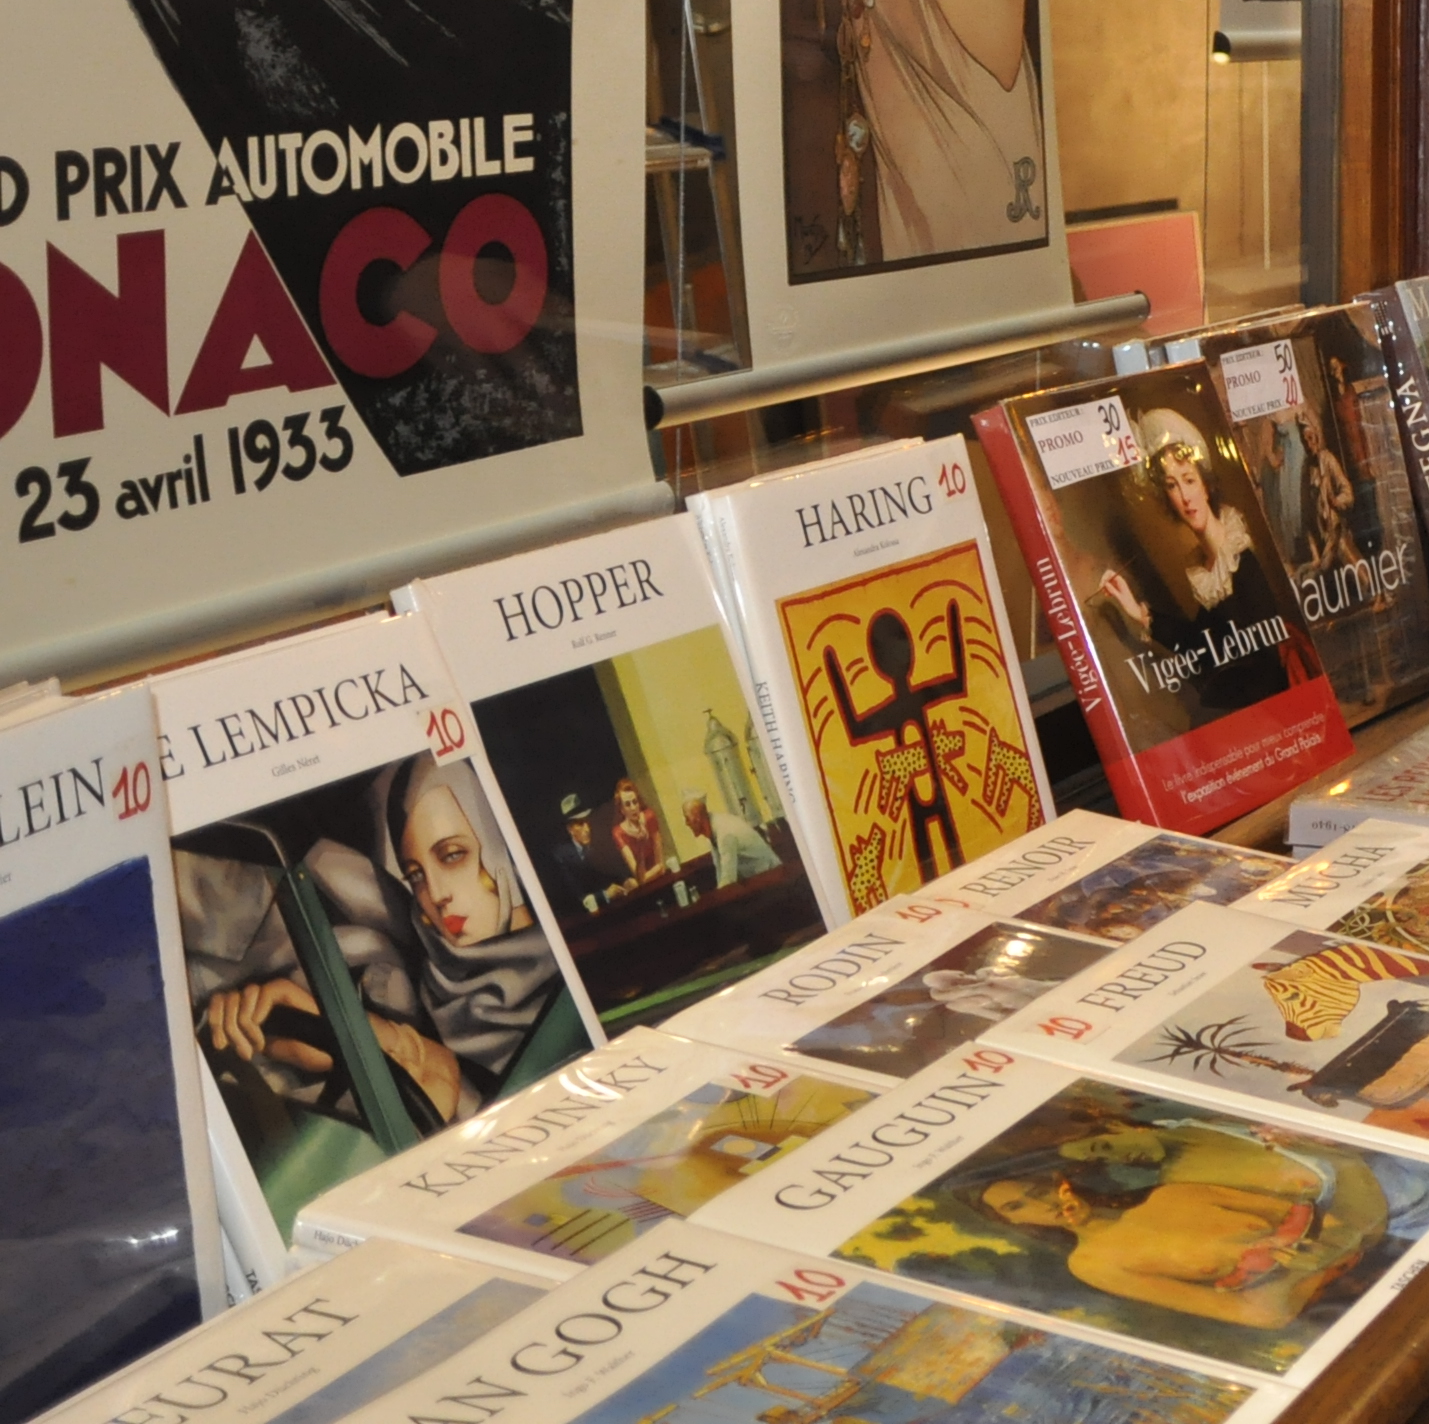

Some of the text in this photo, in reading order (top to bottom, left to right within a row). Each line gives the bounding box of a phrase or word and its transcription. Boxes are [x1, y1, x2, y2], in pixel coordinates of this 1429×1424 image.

[54, 141, 188, 222] PRIX
[205, 114, 535, 206] AUTOMOBILE
[1226, 370, 1262, 390] PROMO
[1274, 343, 1293, 374] 50
[1038, 430, 1084, 454] PROMO
[1098, 403, 1121, 436] 30
[15, 405, 354, 544] 23 avril 1933
[937, 462, 967, 498] 10
[1050, 461, 1095, 487] NOUVEAU
[1117, 435, 1139, 465] 15
[795, 476, 935, 549] HARING
[493, 557, 665, 643] HOPPER
[1290, 540, 1408, 622] aumier
[1036, 557, 1103, 713] Vigée-Lebrun
[1124, 614, 1292, 695] Vigée-Lebrun
[188, 662, 430, 769] LEMPICKA
[426, 708, 467, 758] 10
[756, 681, 779, 734] KEITH
[1264, 751, 1276, 767] du
[1274, 738, 1299, 762] Grand
[112, 761, 152, 822] 10
[958, 834, 1097, 898] RENOIR
[1284, 839, 1398, 910] MUCHA
[894, 902, 944, 925] 10
[758, 931, 907, 1009] RODIN
[1076, 939, 1208, 1013] FREUD
[1036, 1016, 1093, 1041] 10
[730, 1063, 788, 1092] 10
[963, 1048, 1016, 1074] 10
[773, 1066, 1006, 1214] GAUGUIN
[508, 1249, 718, 1378] GOGH
[776, 1266, 847, 1304] 10
